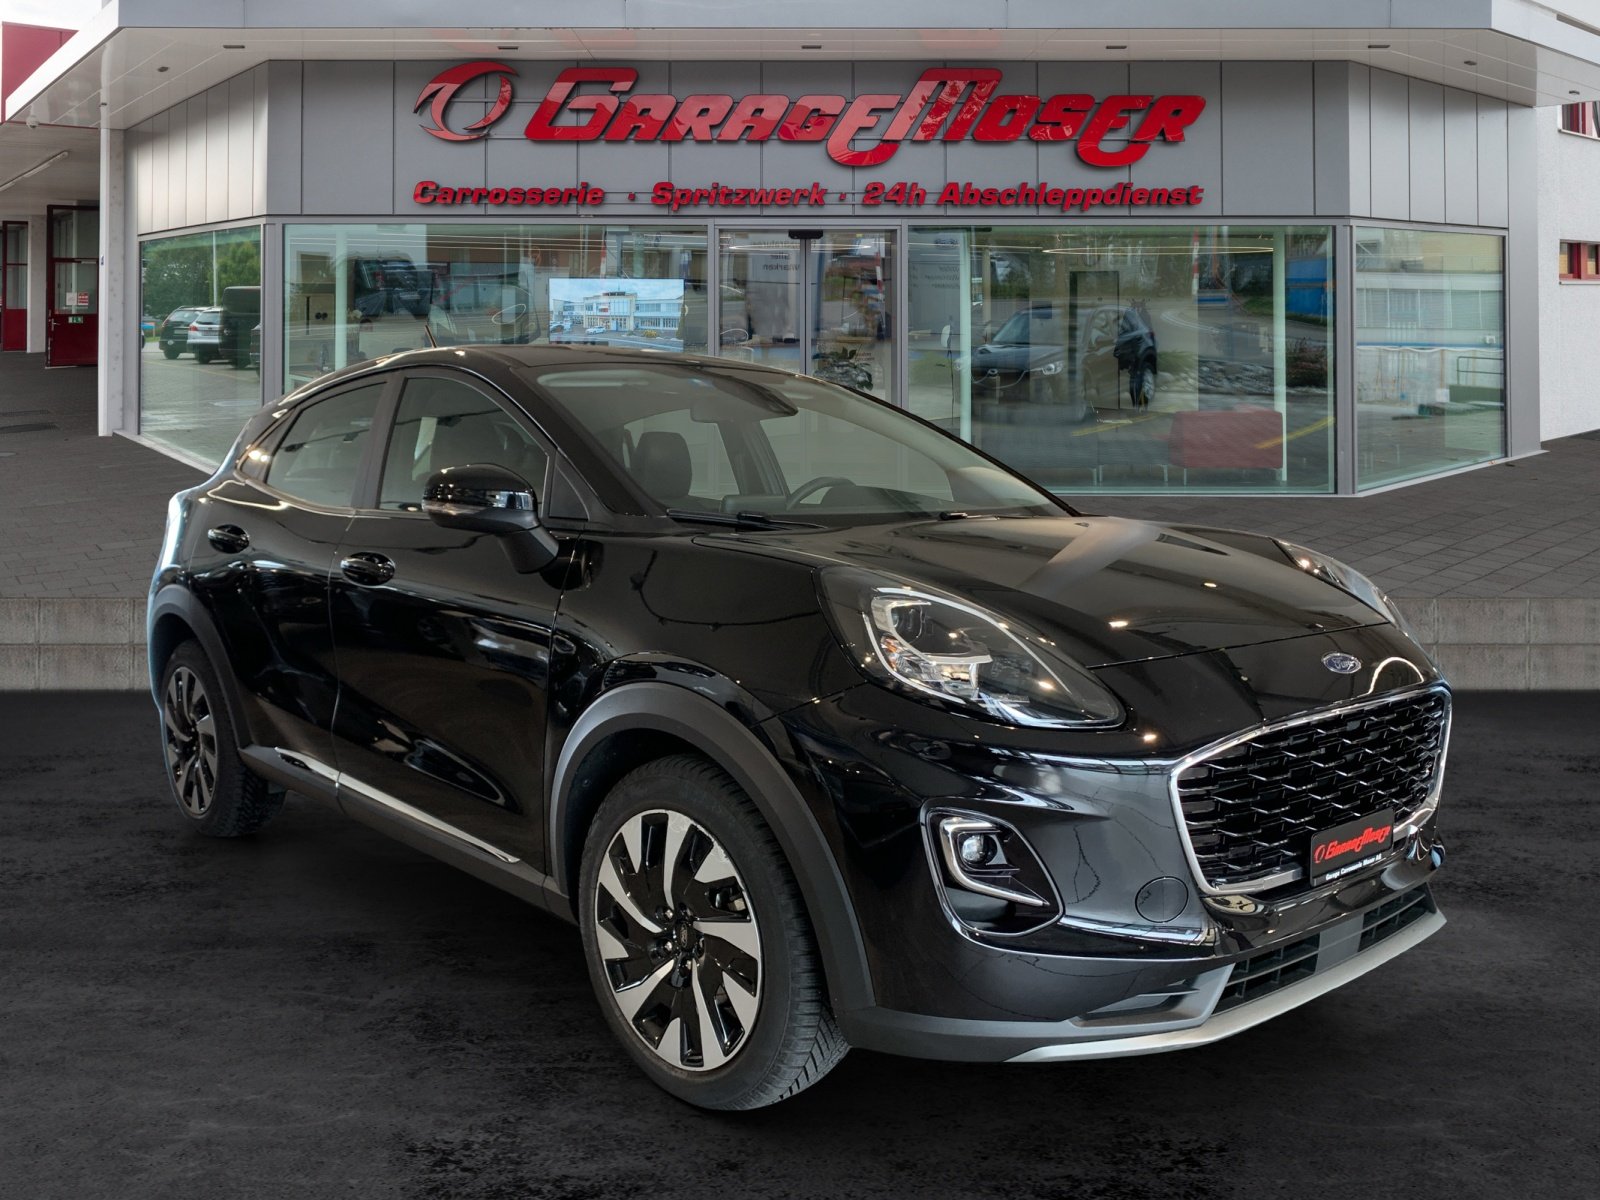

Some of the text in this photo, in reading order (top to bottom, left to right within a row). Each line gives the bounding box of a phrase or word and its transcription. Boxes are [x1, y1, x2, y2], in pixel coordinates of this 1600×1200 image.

[413, 180, 1204, 212] Carrosserie Spritzwerk 24h Abschleppdienst
